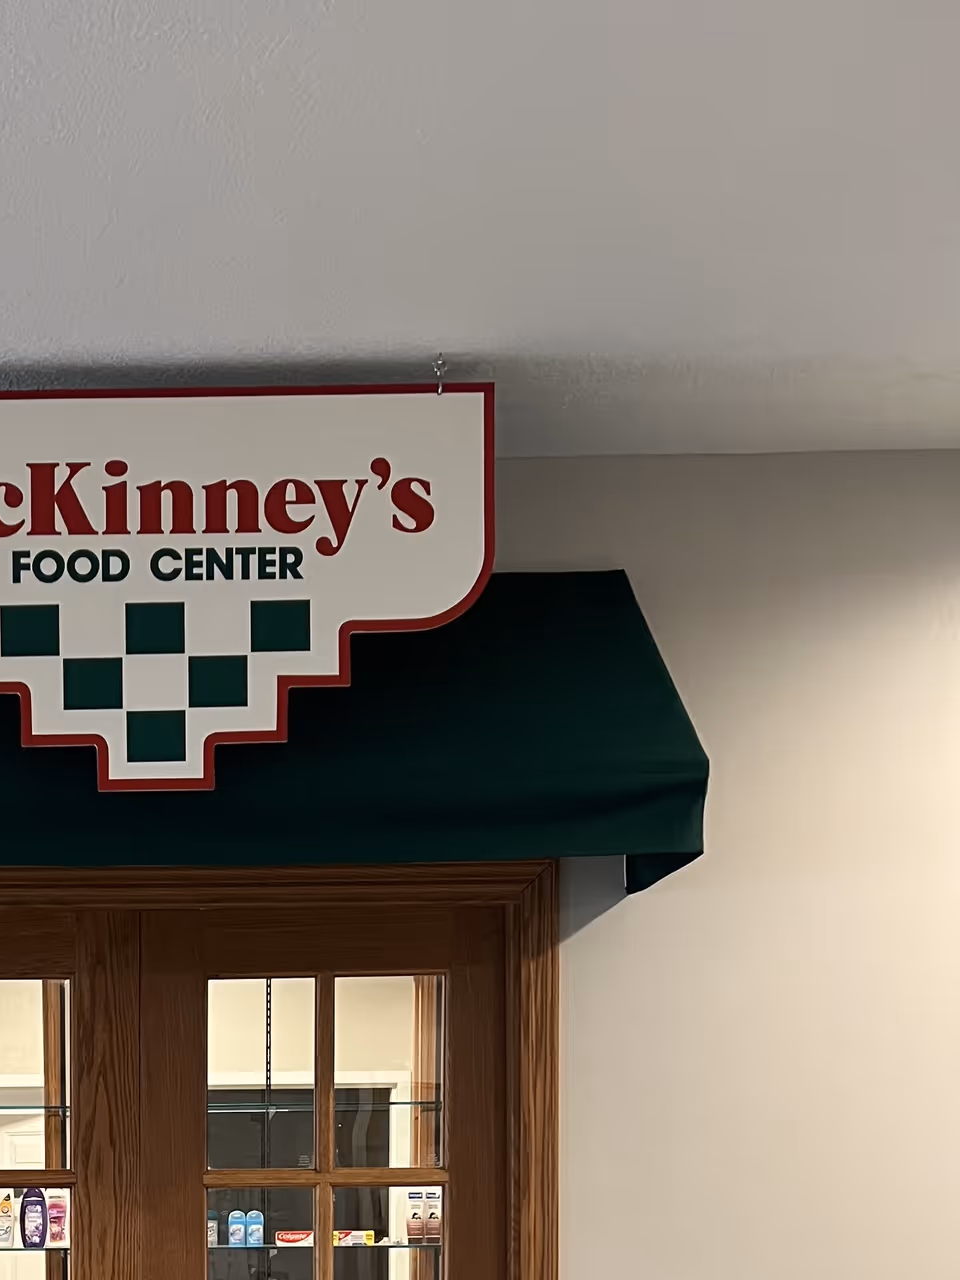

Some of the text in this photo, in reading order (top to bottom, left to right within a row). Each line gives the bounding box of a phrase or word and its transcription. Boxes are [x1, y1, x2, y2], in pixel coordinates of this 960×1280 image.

[11, 546, 305, 584] FOOD CENTER
[278, 1232, 308, 1240] Colgate
